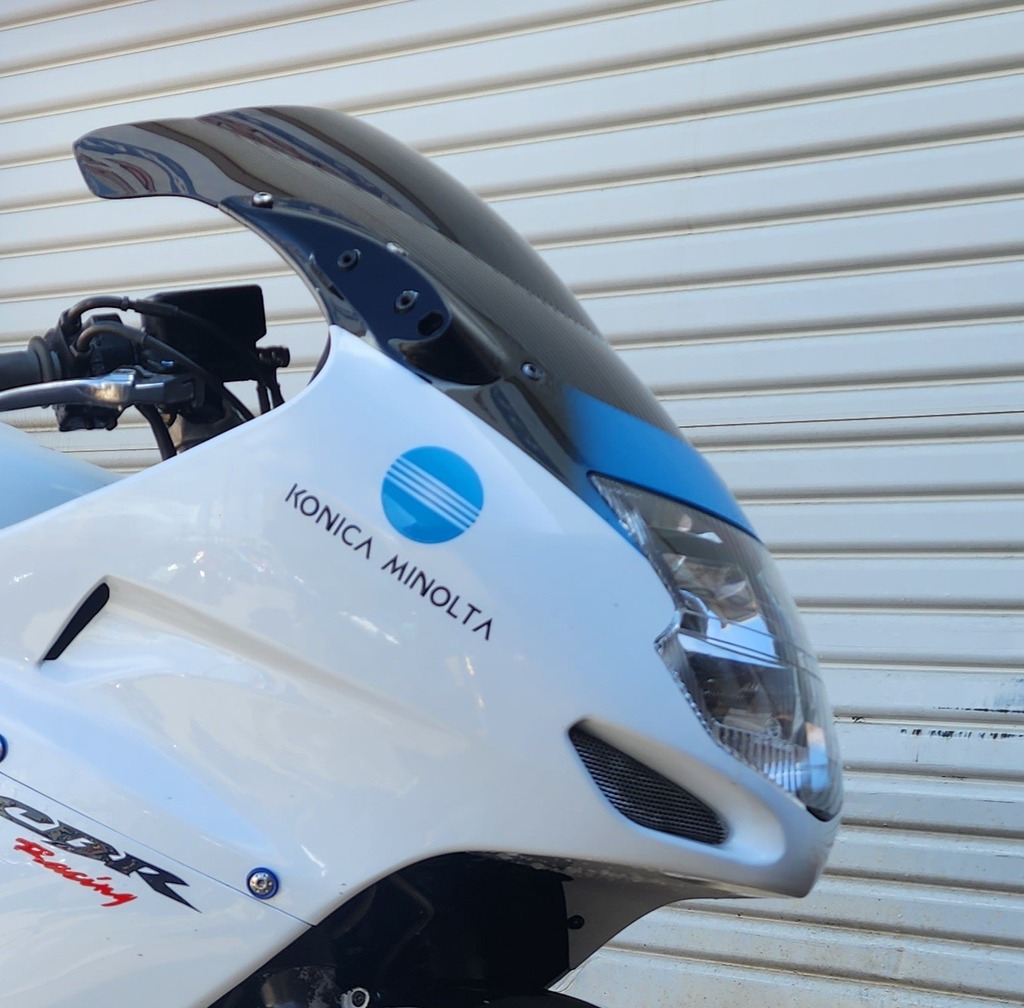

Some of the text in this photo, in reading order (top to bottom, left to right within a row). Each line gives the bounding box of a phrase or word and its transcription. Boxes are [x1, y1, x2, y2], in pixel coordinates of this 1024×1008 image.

[284, 483, 493, 641] KONICA MINOLTA
[13, 837, 138, 907] Racing
